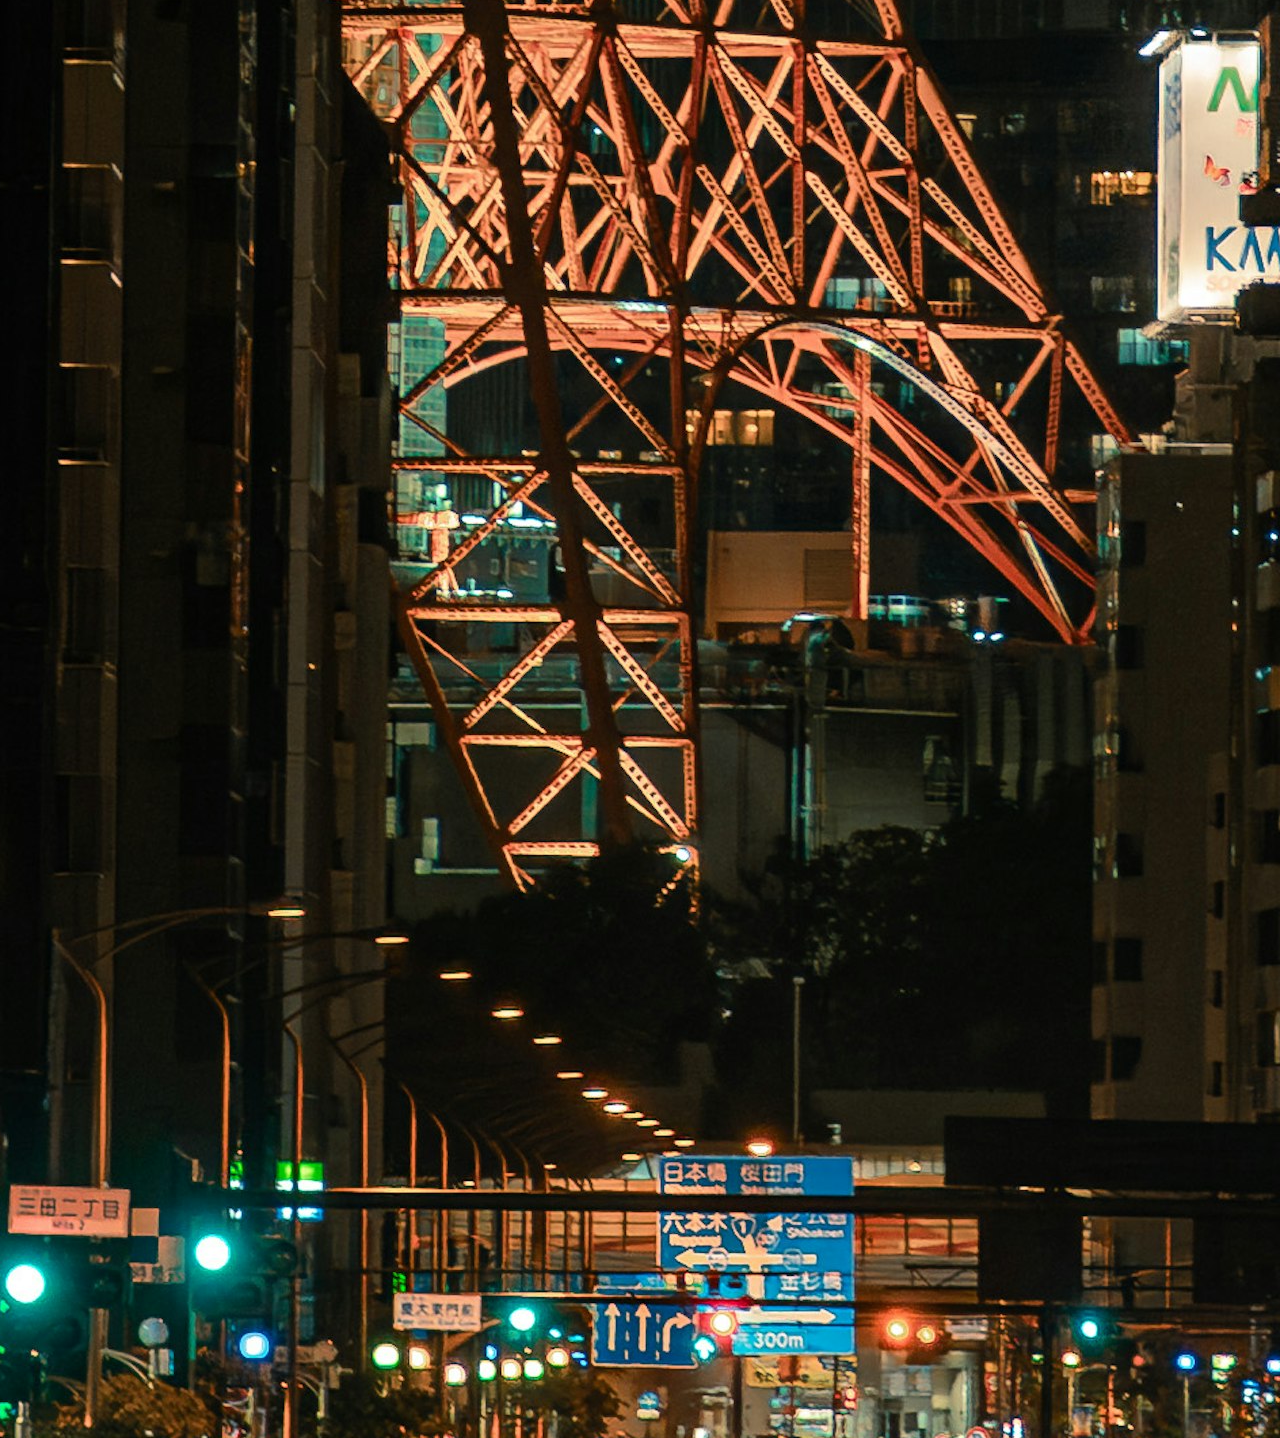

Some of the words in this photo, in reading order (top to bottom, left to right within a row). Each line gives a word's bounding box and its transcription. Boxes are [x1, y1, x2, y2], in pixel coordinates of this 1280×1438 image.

[17, 1197, 119, 1218] 三田二丁目
[663, 1212, 728, 1234] 六本木
[754, 1332, 804, 1348] 300m
